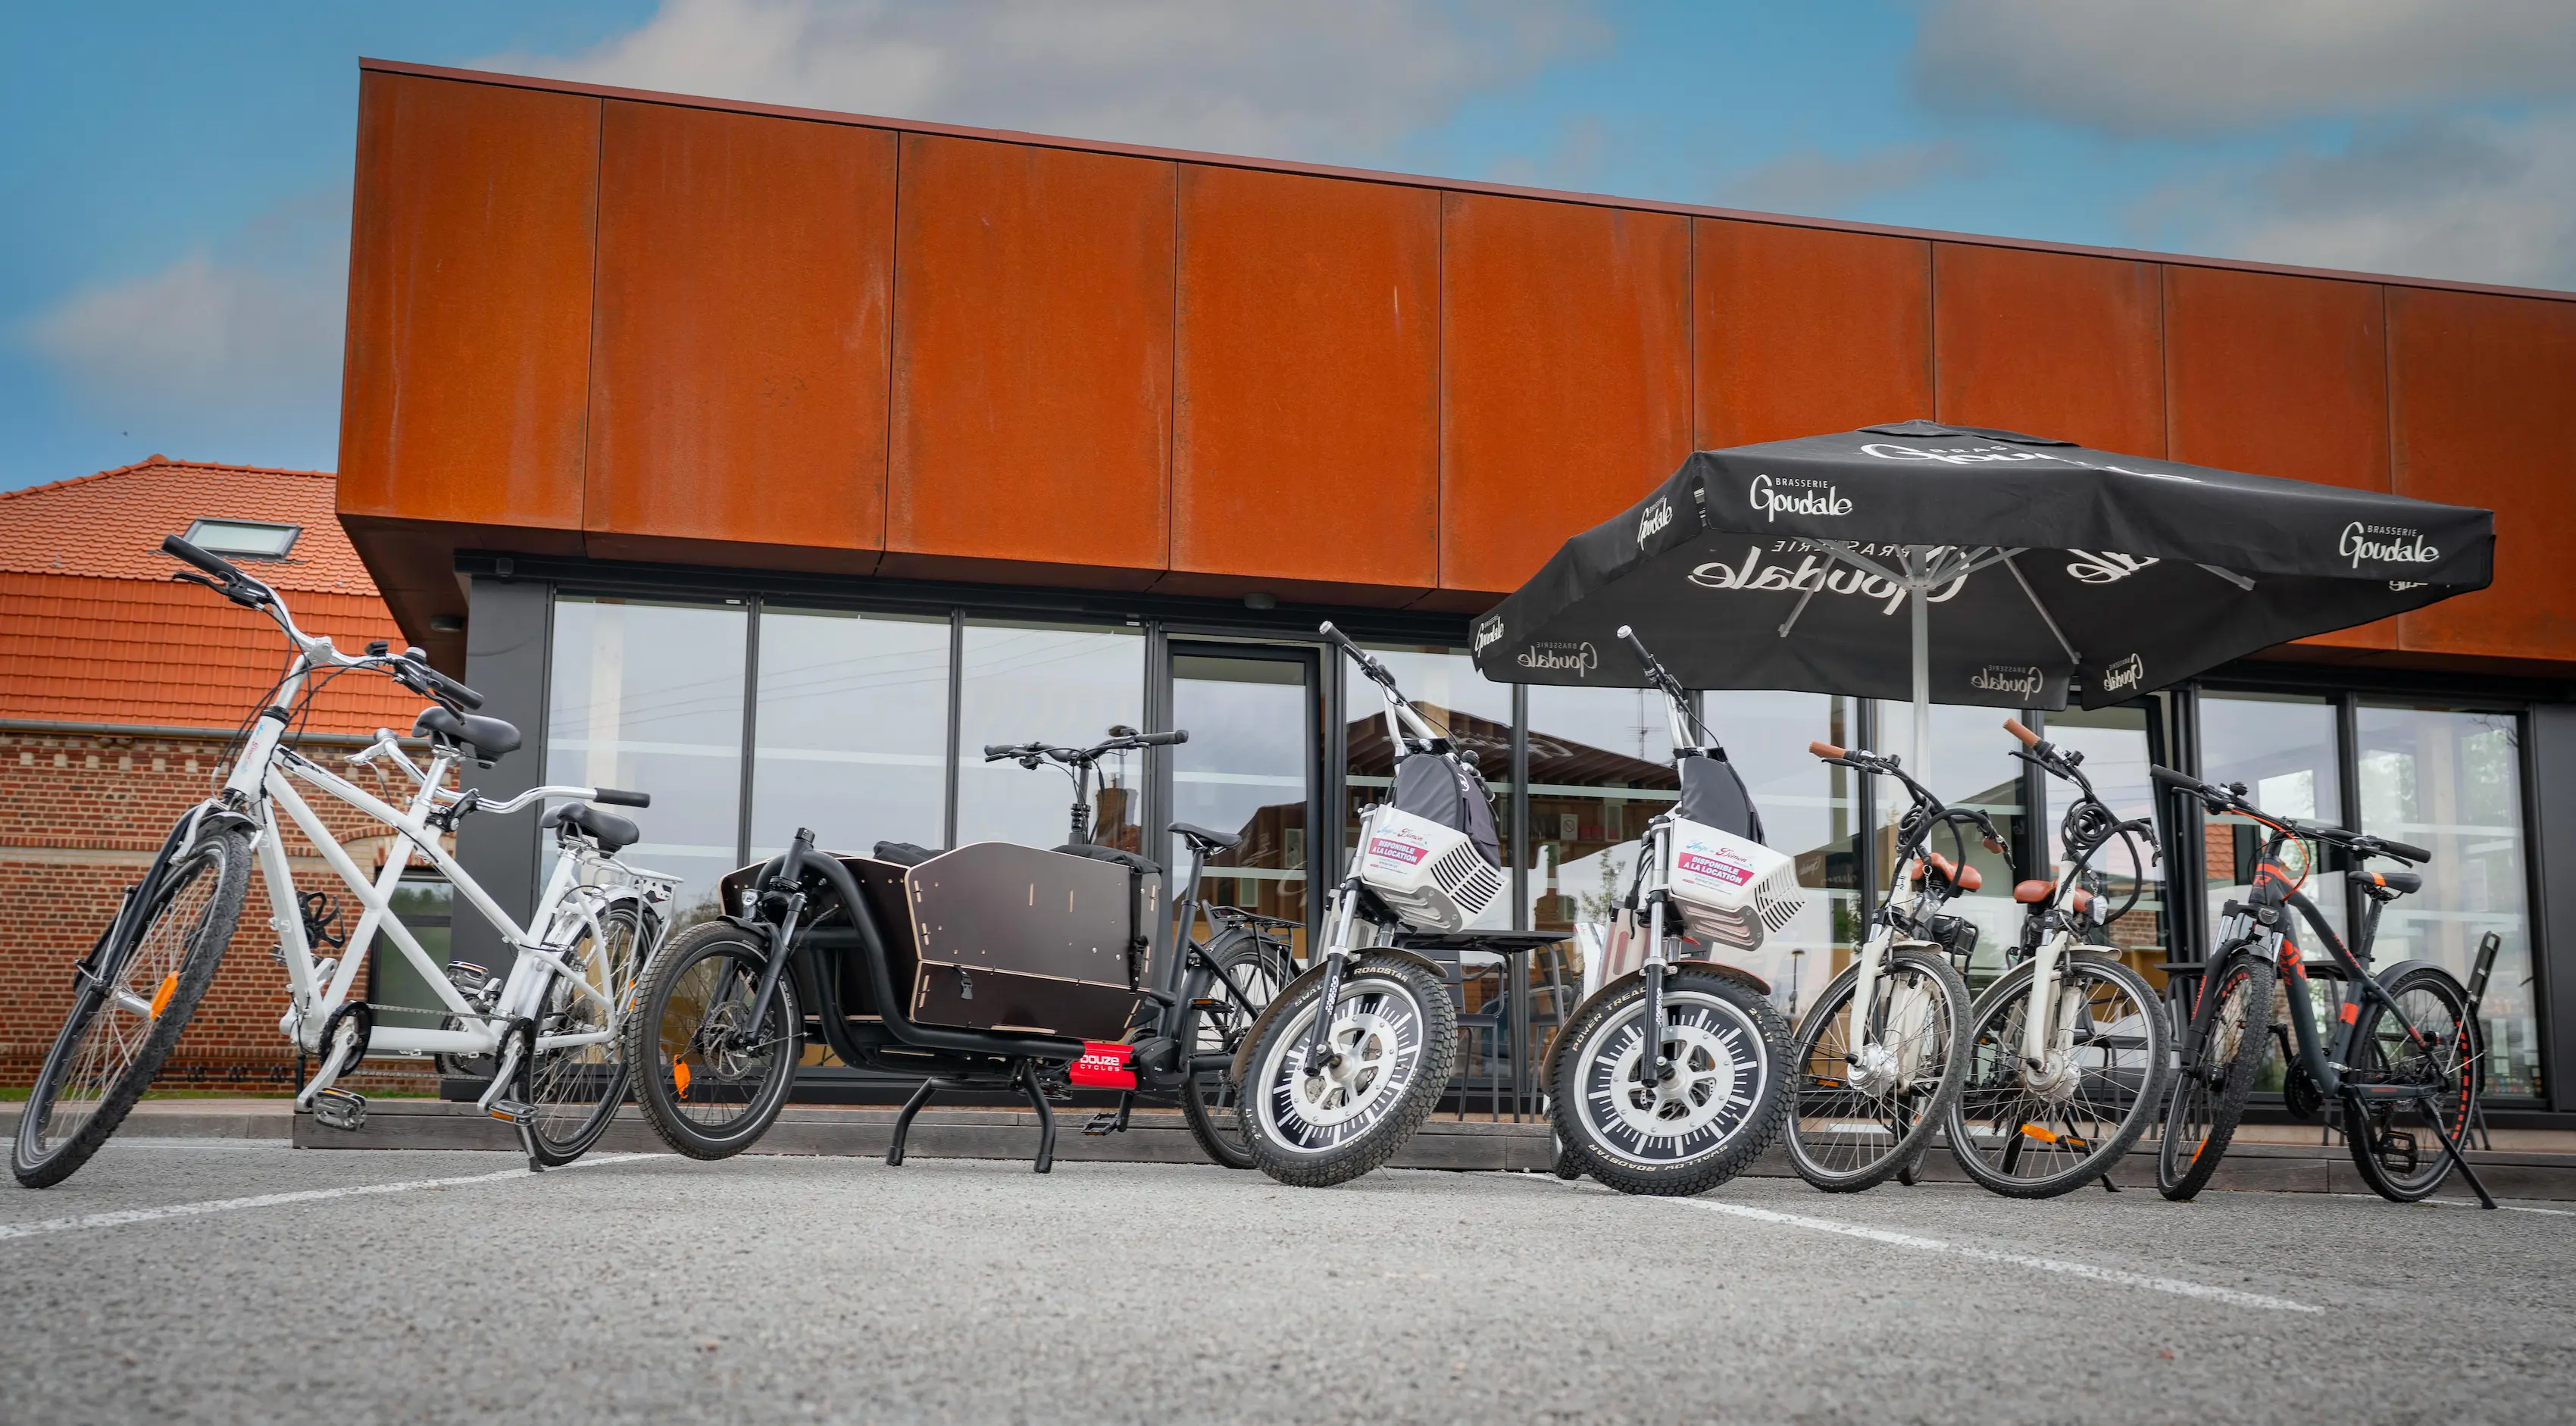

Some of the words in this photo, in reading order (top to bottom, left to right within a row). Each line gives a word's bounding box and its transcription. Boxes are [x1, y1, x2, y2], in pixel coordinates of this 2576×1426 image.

[1775, 477, 1828, 489] BRASSERIE
[1749, 474, 1853, 523] Goudale
[2367, 524, 2417, 536] BRASSERIE
[2339, 521, 2440, 569] Goudale
[1378, 840, 1416, 855] DISPONIBLE
[1384, 849, 1418, 863] LOCATION
[1690, 863, 1701, 871] LA
[1701, 865, 1743, 884] LOCATION
[1691, 856, 1740, 875] DISPONIBLE
[1354, 967, 1408, 983] ROADSTAR
[1571, 1012, 1602, 1052] POWER
[1587, 1143, 1657, 1172] ROADSTAR
[1664, 1144, 1728, 1171] SWALLOW
